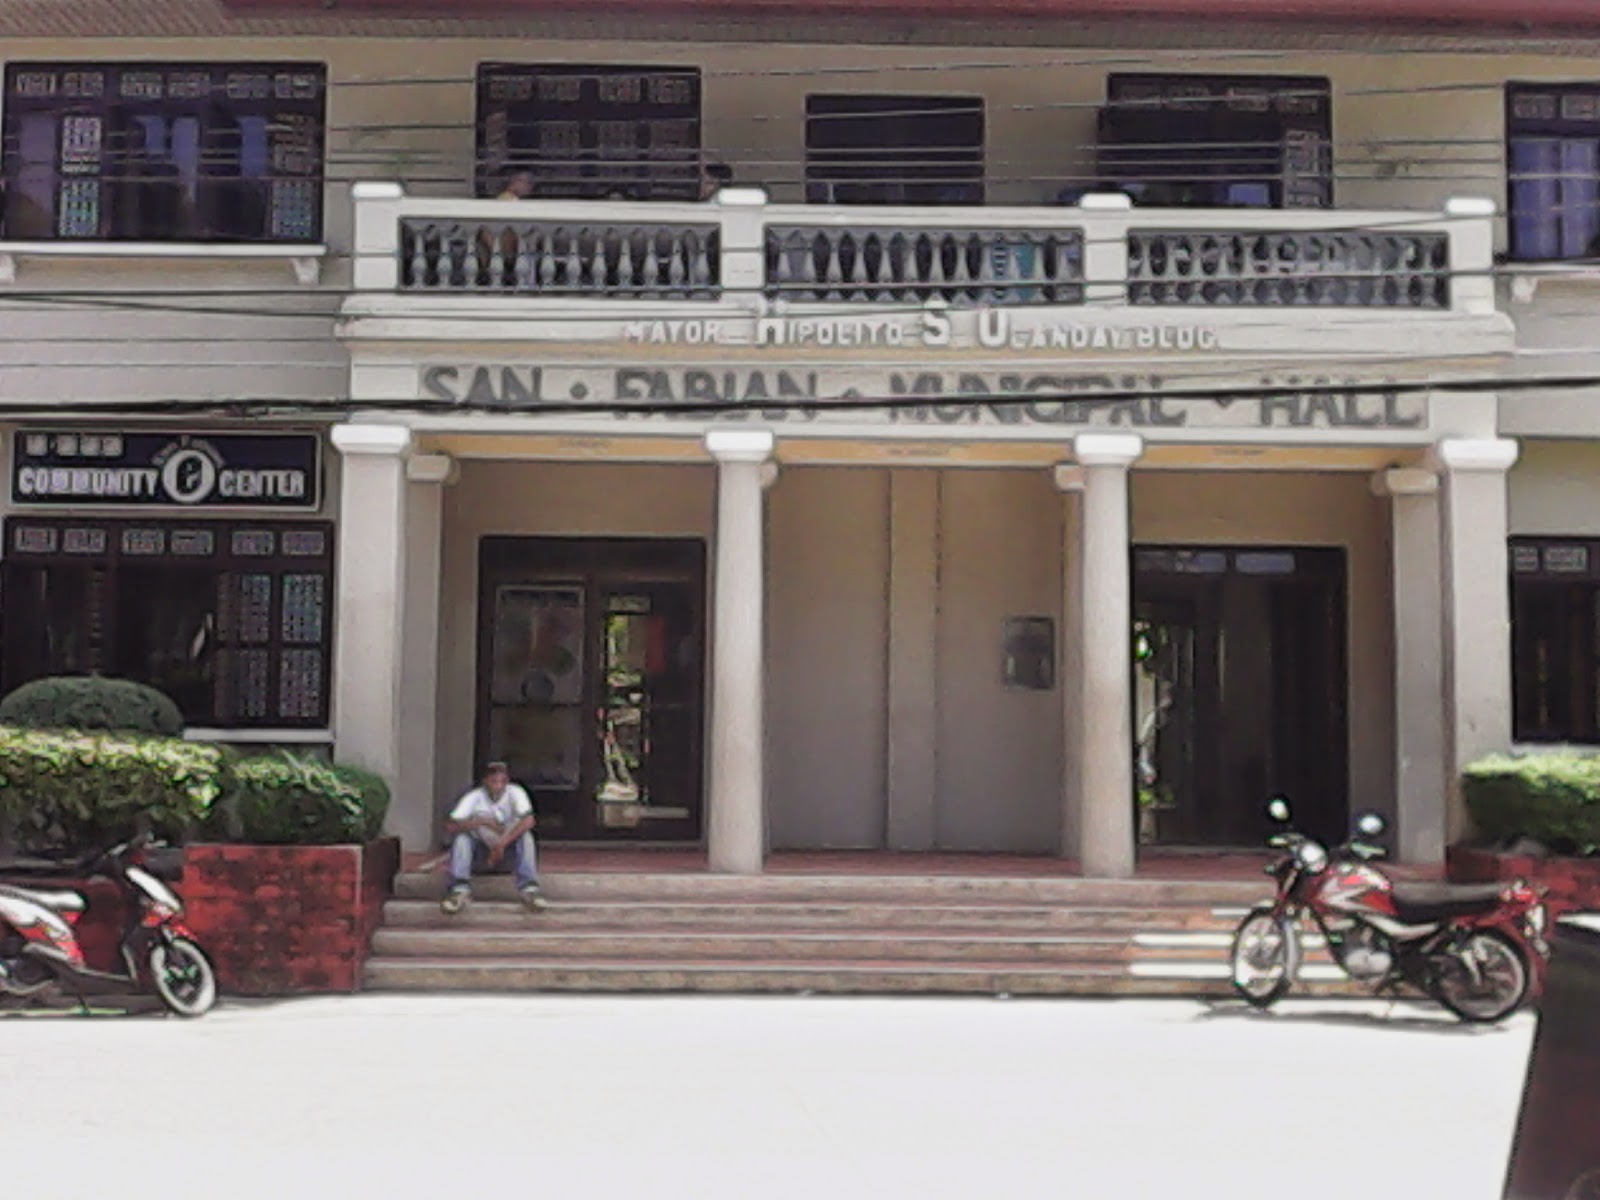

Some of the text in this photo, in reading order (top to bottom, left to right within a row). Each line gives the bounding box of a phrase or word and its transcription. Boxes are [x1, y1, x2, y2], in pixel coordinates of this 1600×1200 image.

[624, 320, 719, 344] MAYOR
[923, 299, 950, 346] S
[424, 366, 1422, 426] SAN FABIAN MUNICIPAL HALL
[18, 467, 305, 497] COMMUNITY CENTER
